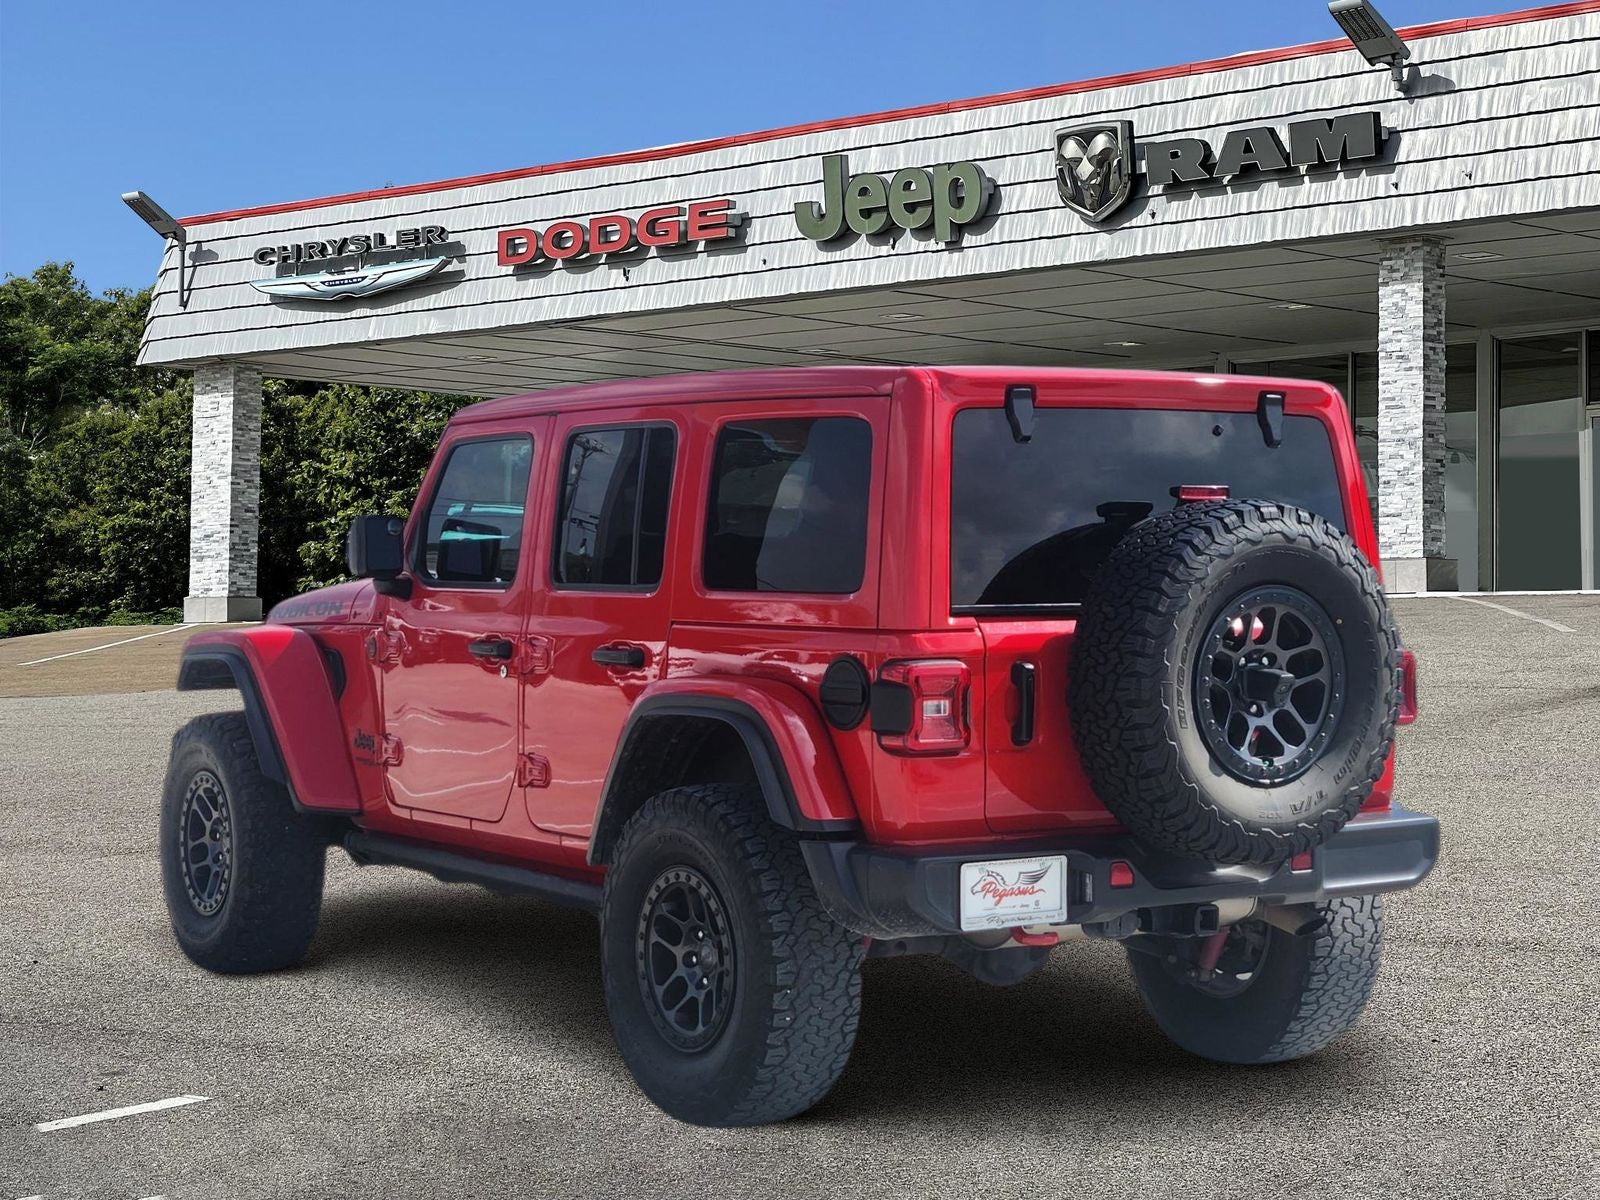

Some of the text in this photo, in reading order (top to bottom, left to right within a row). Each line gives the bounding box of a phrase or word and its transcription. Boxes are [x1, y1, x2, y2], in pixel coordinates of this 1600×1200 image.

[1144, 111, 1379, 186] RAM
[794, 154, 989, 242] Jeep
[253, 225, 448, 266] CHRYSLER
[497, 198, 733, 267] DODGE
[324, 277, 362, 286] CHRYSLER
[981, 881, 1044, 906] Pegasus
